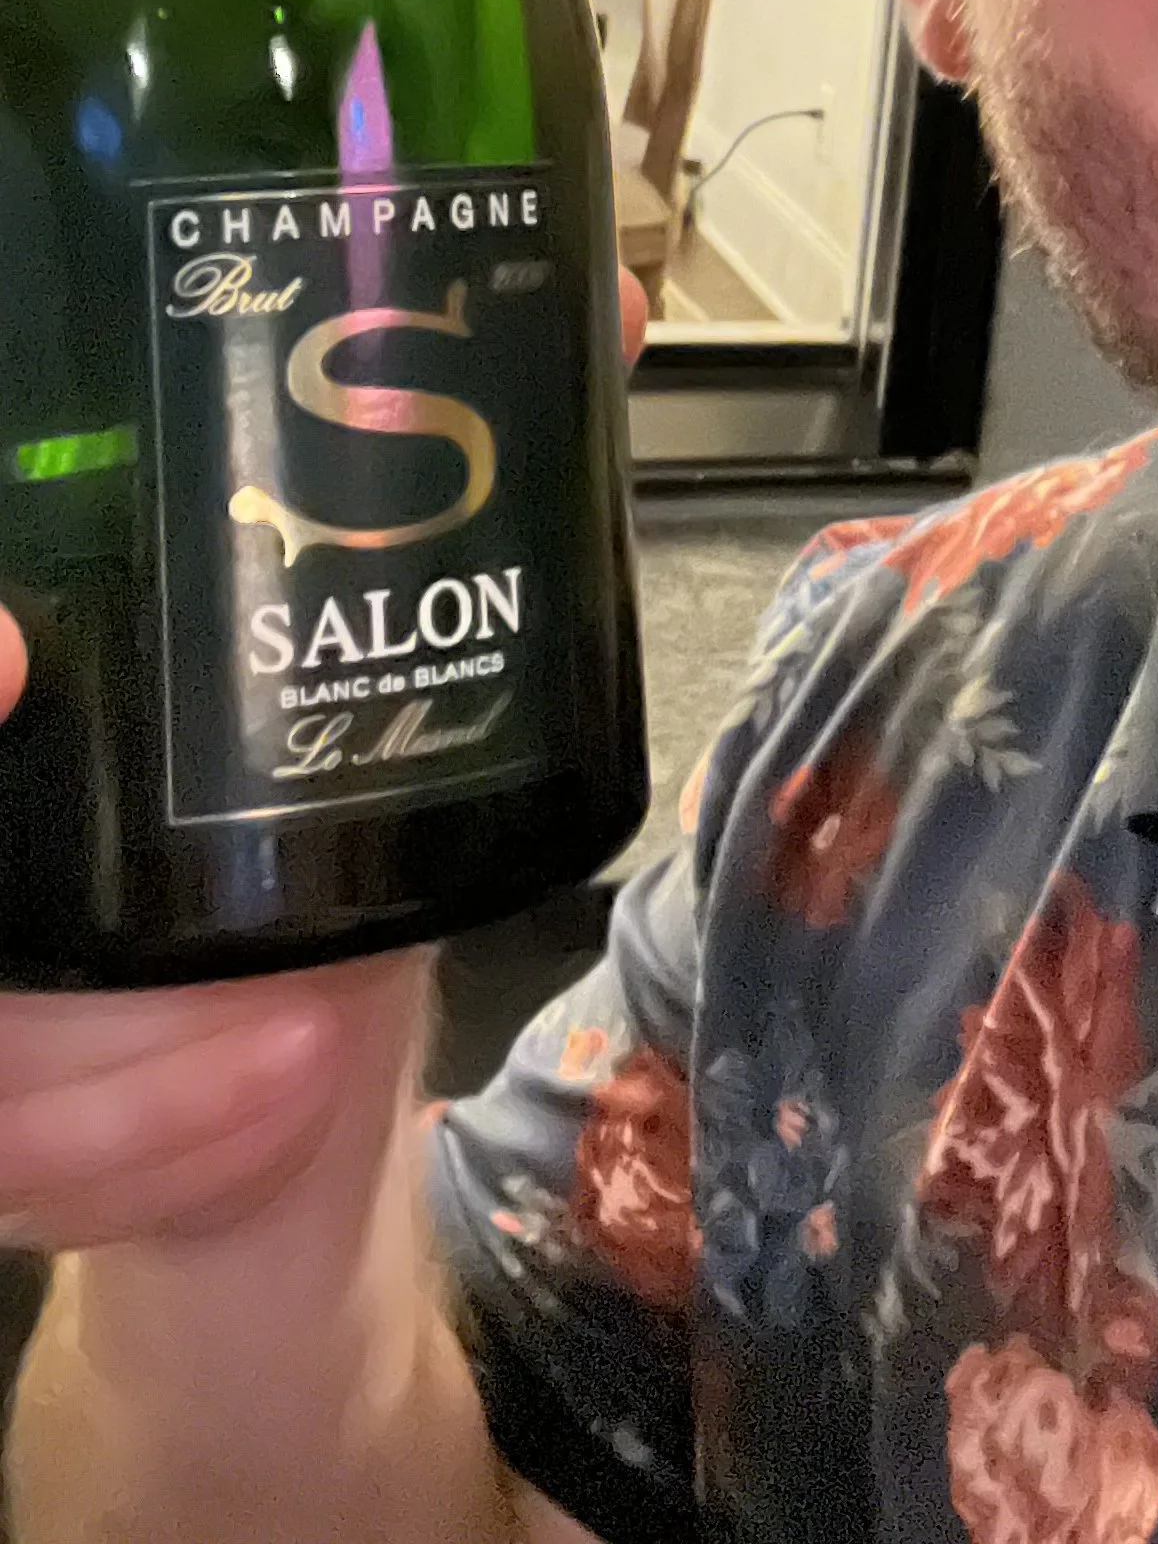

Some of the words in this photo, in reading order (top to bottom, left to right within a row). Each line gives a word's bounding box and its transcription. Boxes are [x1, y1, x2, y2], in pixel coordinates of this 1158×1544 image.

[170, 189, 538, 248] CHAMPAGNE
[165, 253, 305, 318] Brut
[228, 278, 496, 569] S
[249, 566, 522, 675] SALON
[280, 675, 370, 710] BLANC
[378, 674, 406, 693] de
[414, 651, 505, 690] BLANCS
